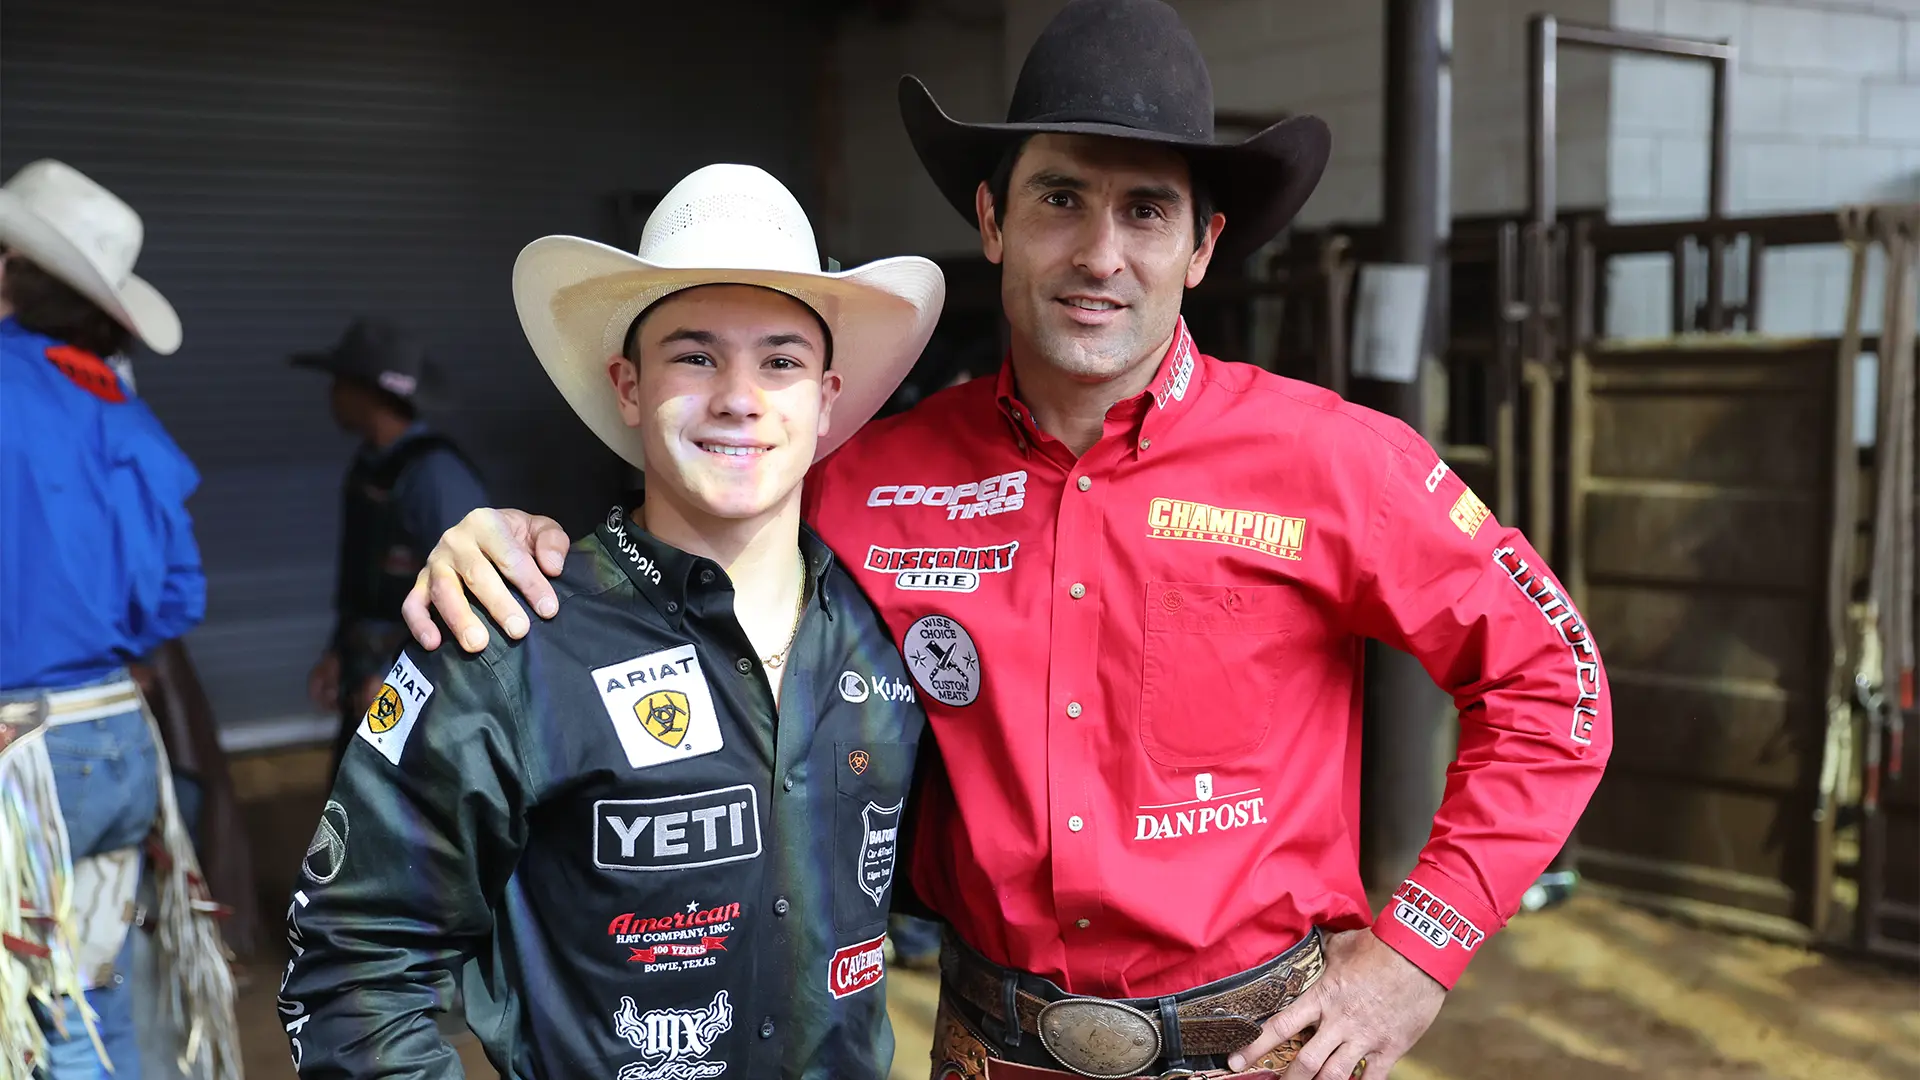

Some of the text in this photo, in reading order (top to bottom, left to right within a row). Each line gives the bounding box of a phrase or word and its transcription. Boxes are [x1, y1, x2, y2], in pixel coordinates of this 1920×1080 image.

[866, 470, 1028, 507] COOPER
[946, 493, 1025, 521] TIRES
[1151, 499, 1303, 548] CHAMPION
[616, 525, 662, 586] Kubota
[866, 543, 1014, 572] DISCOUNT
[1153, 529, 1297, 558] POWER EQUIPMENT
[907, 574, 968, 587] TIRE
[920, 628, 957, 639] CHOICE
[921, 618, 951, 630] WISE
[391, 661, 426, 702] RIAT
[606, 656, 694, 693] ARIAT
[931, 680, 970, 692] CUSTOM
[938, 690, 969, 702] MEATS
[605, 801, 745, 858] YETI
[1134, 809, 1196, 840] DAN
[607, 902, 741, 935] American
[616, 922, 735, 944] HAT COMPANY, INC.
[1403, 907, 1443, 942] TIRE
[653, 944, 707, 956] 100 YEARS
[683, 957, 716, 969] TEXAS
